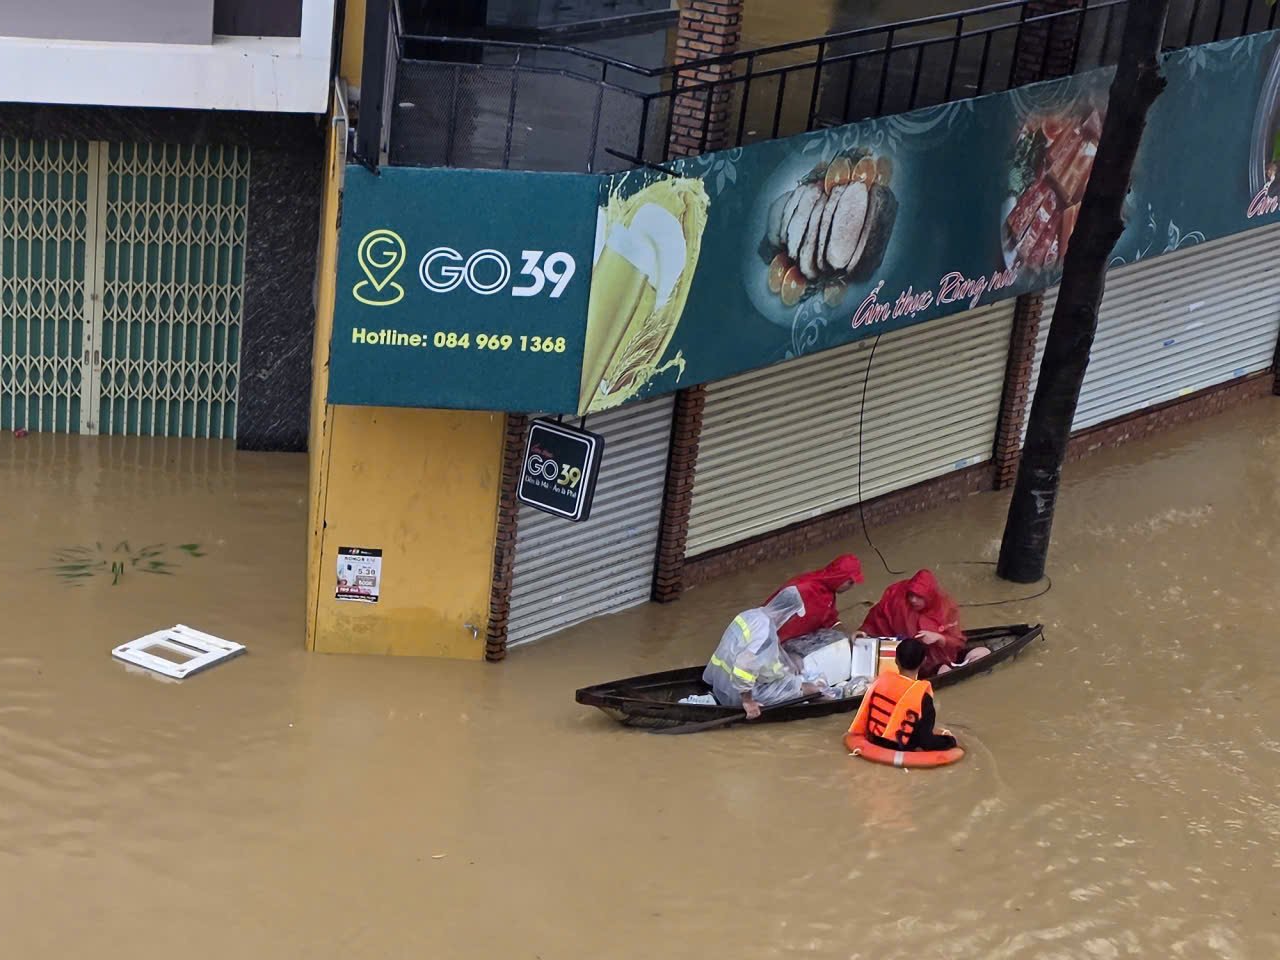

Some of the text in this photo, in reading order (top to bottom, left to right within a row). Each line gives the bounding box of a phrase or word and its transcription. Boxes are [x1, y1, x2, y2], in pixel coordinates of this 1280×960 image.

[351, 327, 566, 353] Hotline: 084 969 1368
